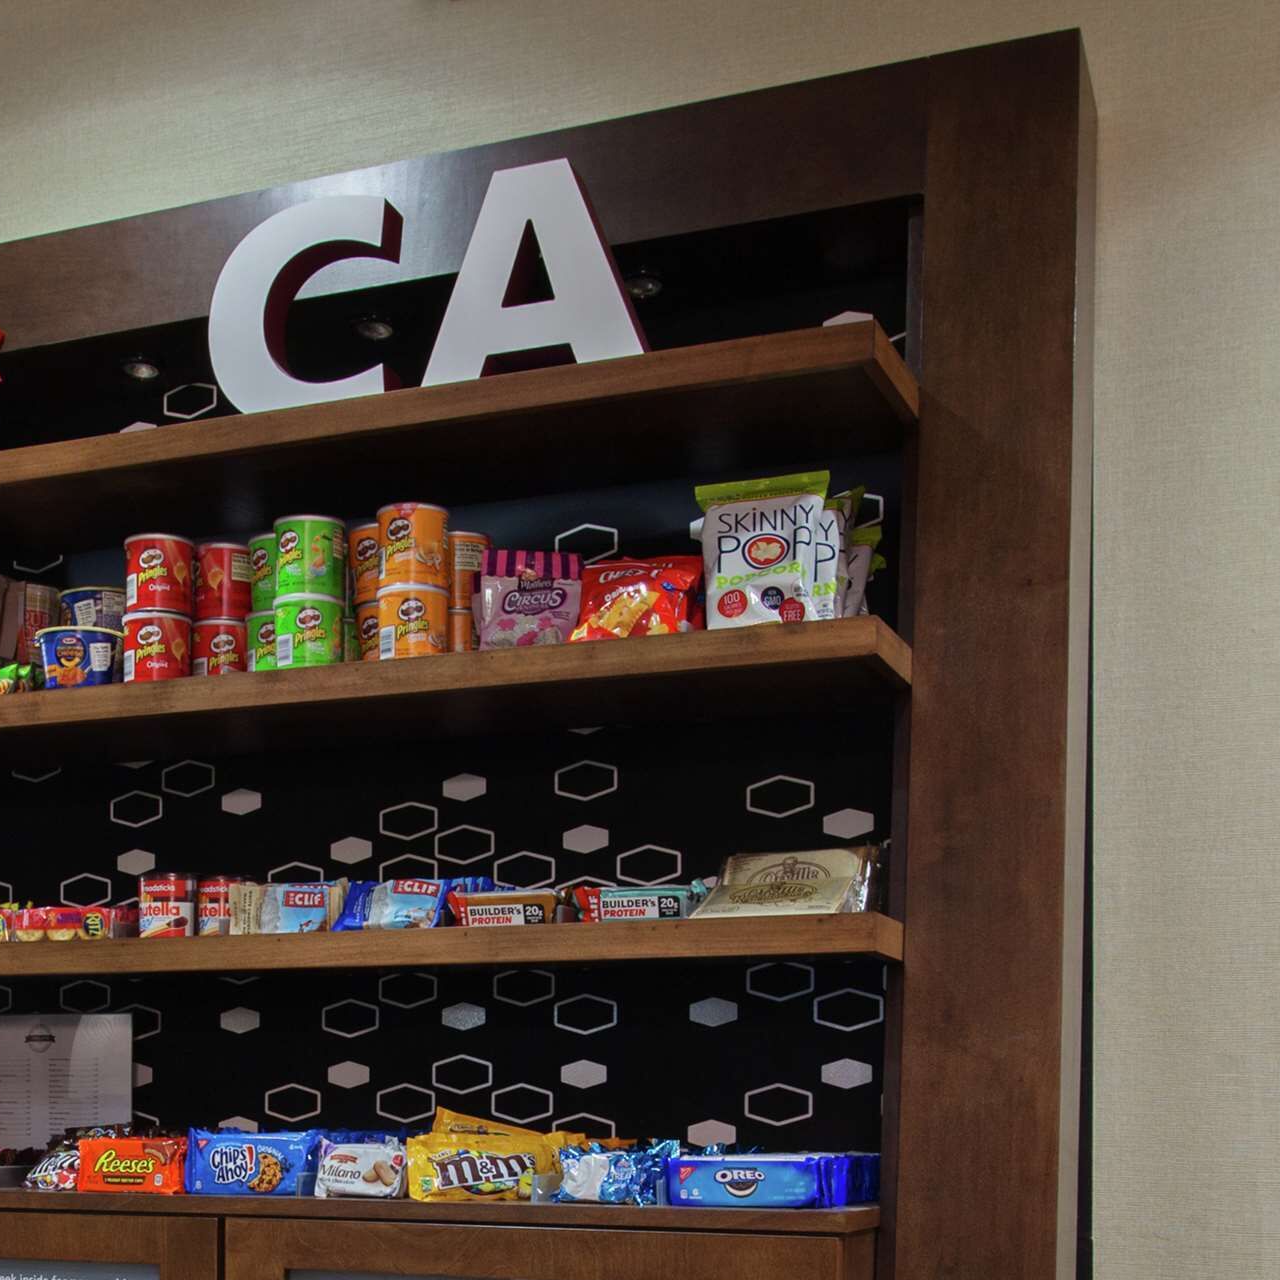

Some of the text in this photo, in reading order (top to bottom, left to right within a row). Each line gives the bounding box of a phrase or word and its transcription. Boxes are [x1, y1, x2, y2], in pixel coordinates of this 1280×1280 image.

[208, 157, 648, 414] CA
[717, 525, 812, 573] POP
[138, 567, 167, 586] Pringles
[723, 592, 739, 604] 100
[783, 611, 801, 622] FREE
[295, 628, 326, 648] Pringles
[396, 620, 429, 640] Pringles
[136, 642, 165, 662] Pringles
[404, 880, 439, 897] CLIF
[294, 893, 323, 906] CLIF
[143, 902, 180, 917] utella
[603, 909, 646, 918] PROTEIN
[471, 916, 513, 925] PROTEIN
[94, 1150, 156, 1173] Reese's
[211, 1147, 247, 1169] Chips
[321, 1165, 361, 1179] Milano
[715, 1168, 765, 1183] OREO
